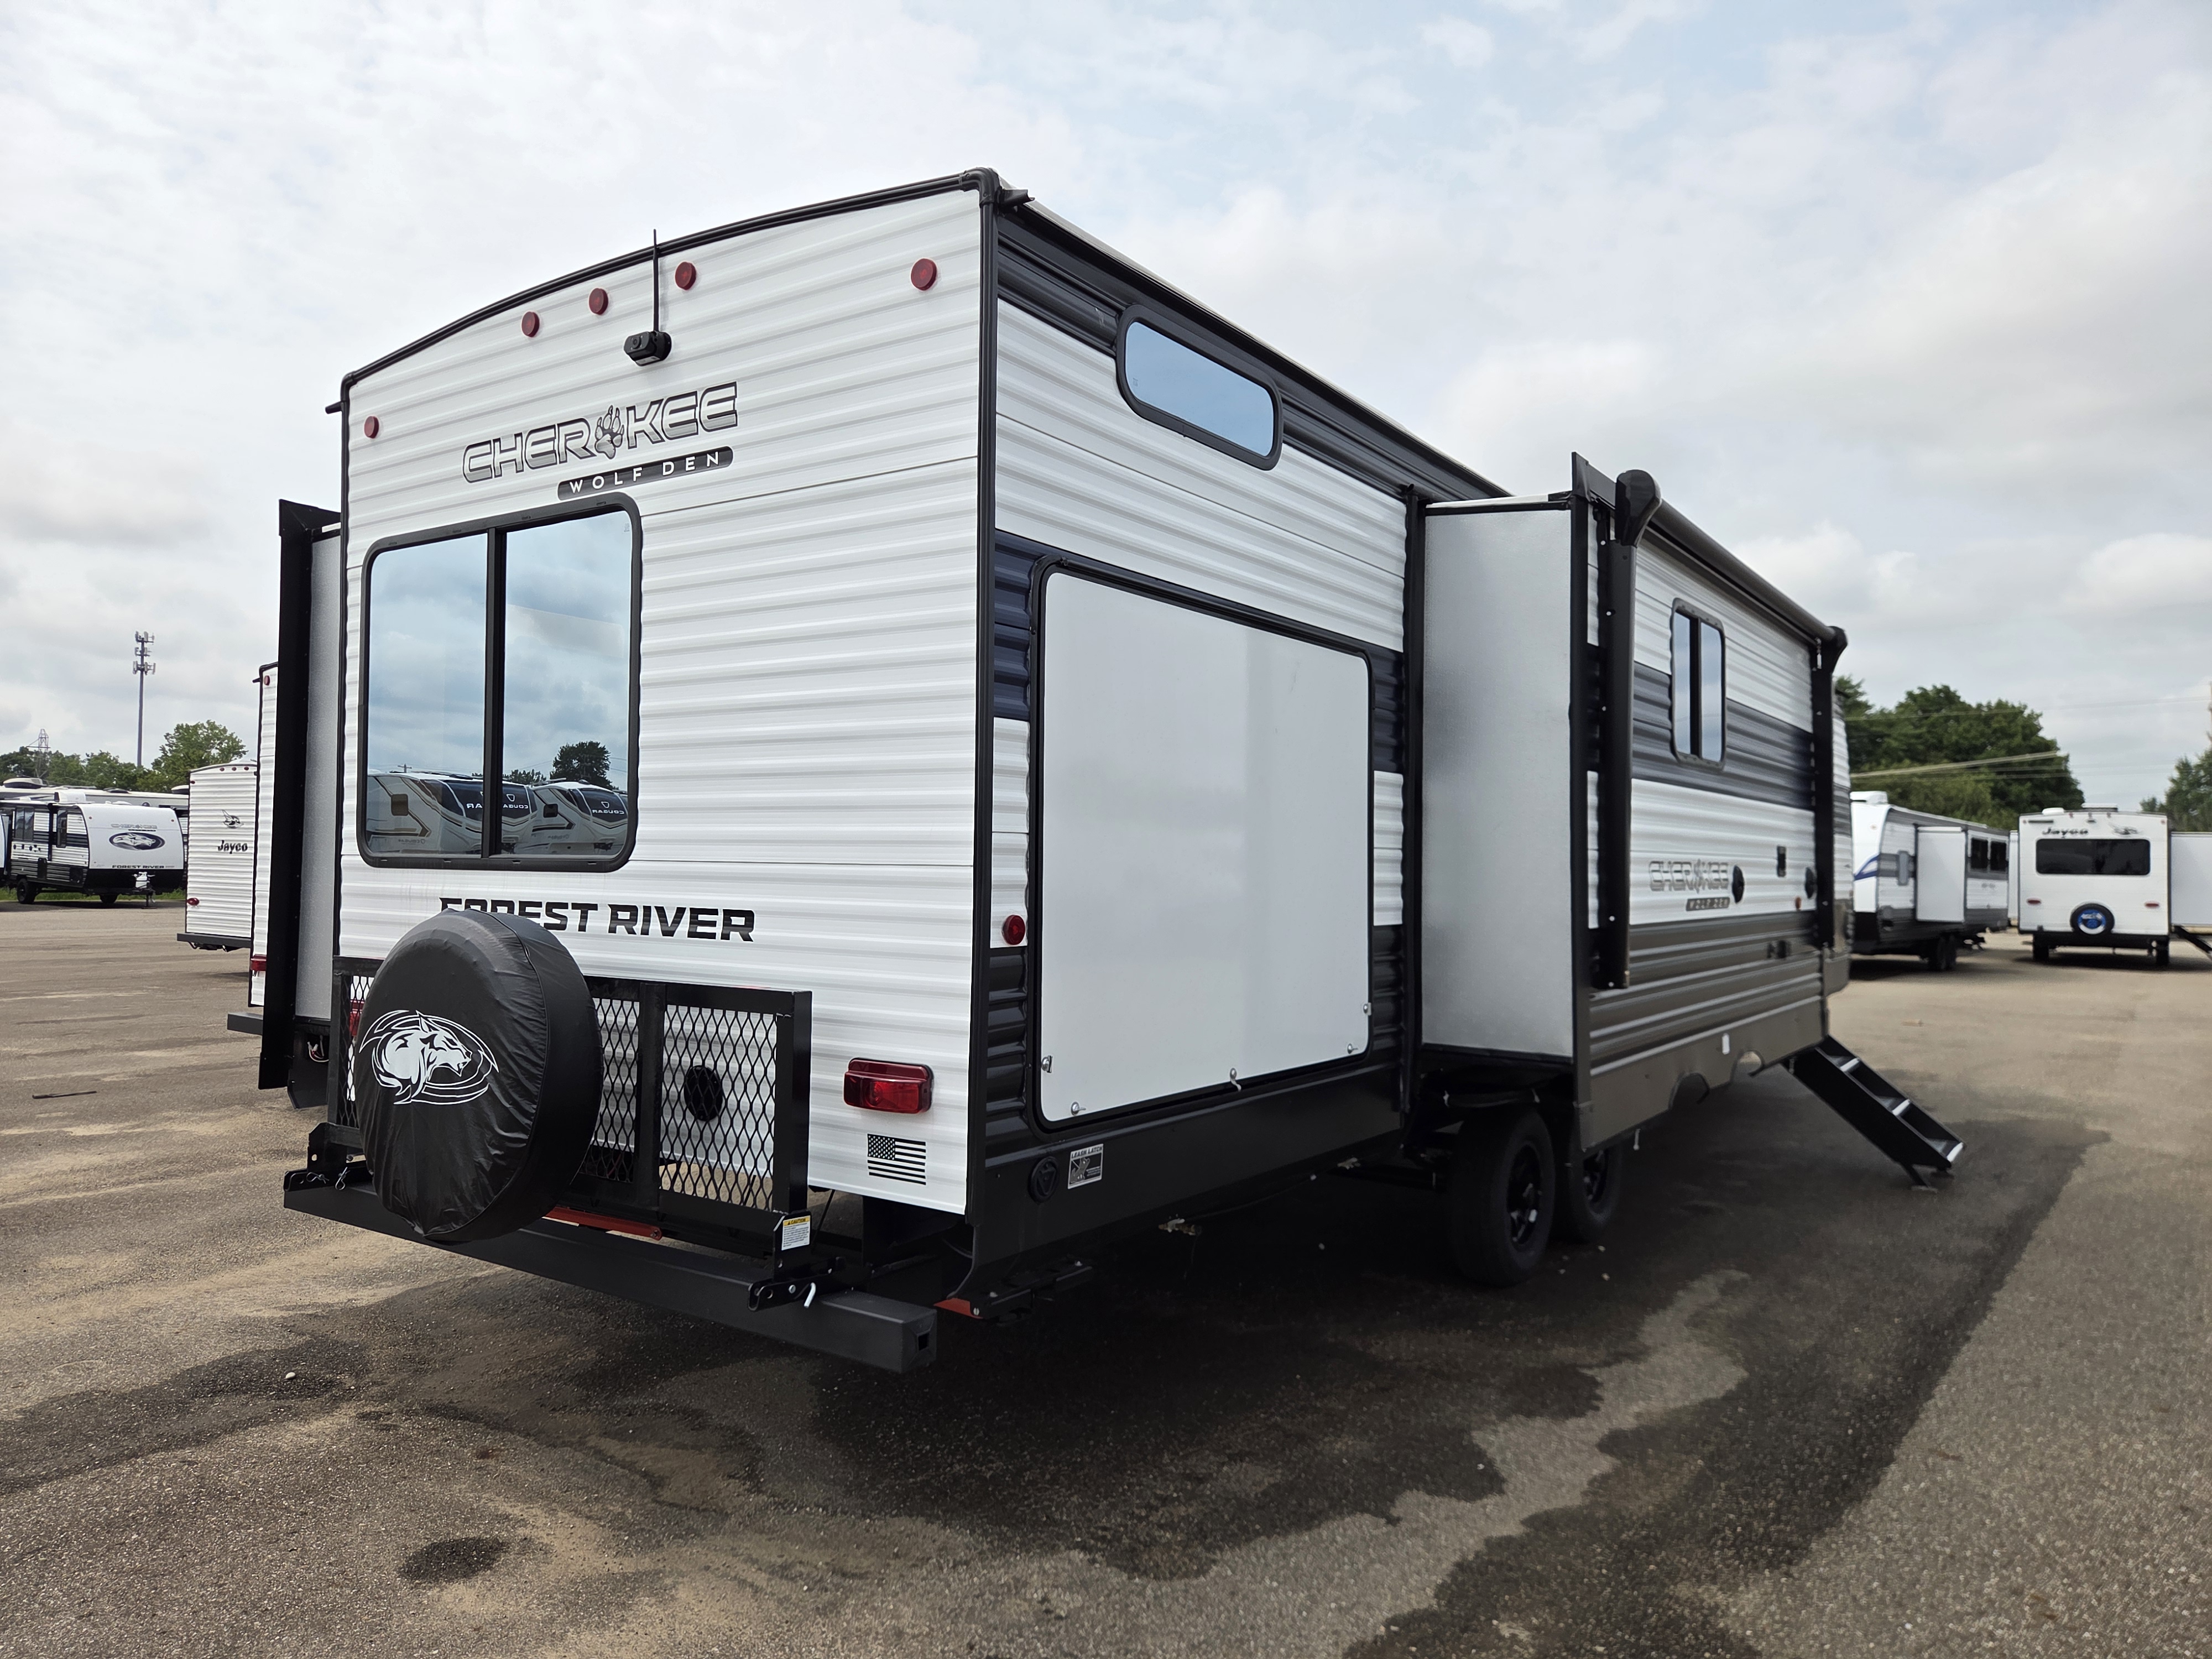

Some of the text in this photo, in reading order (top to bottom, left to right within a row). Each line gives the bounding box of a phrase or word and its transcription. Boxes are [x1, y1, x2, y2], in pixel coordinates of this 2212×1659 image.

[463, 382, 738, 483] CHEROKEE
[570, 451, 719, 493] WOLF DEN
[217, 839, 248, 854] Jayco
[2042, 828, 2089, 838] Jayco
[607, 904, 755, 942] RIVER
